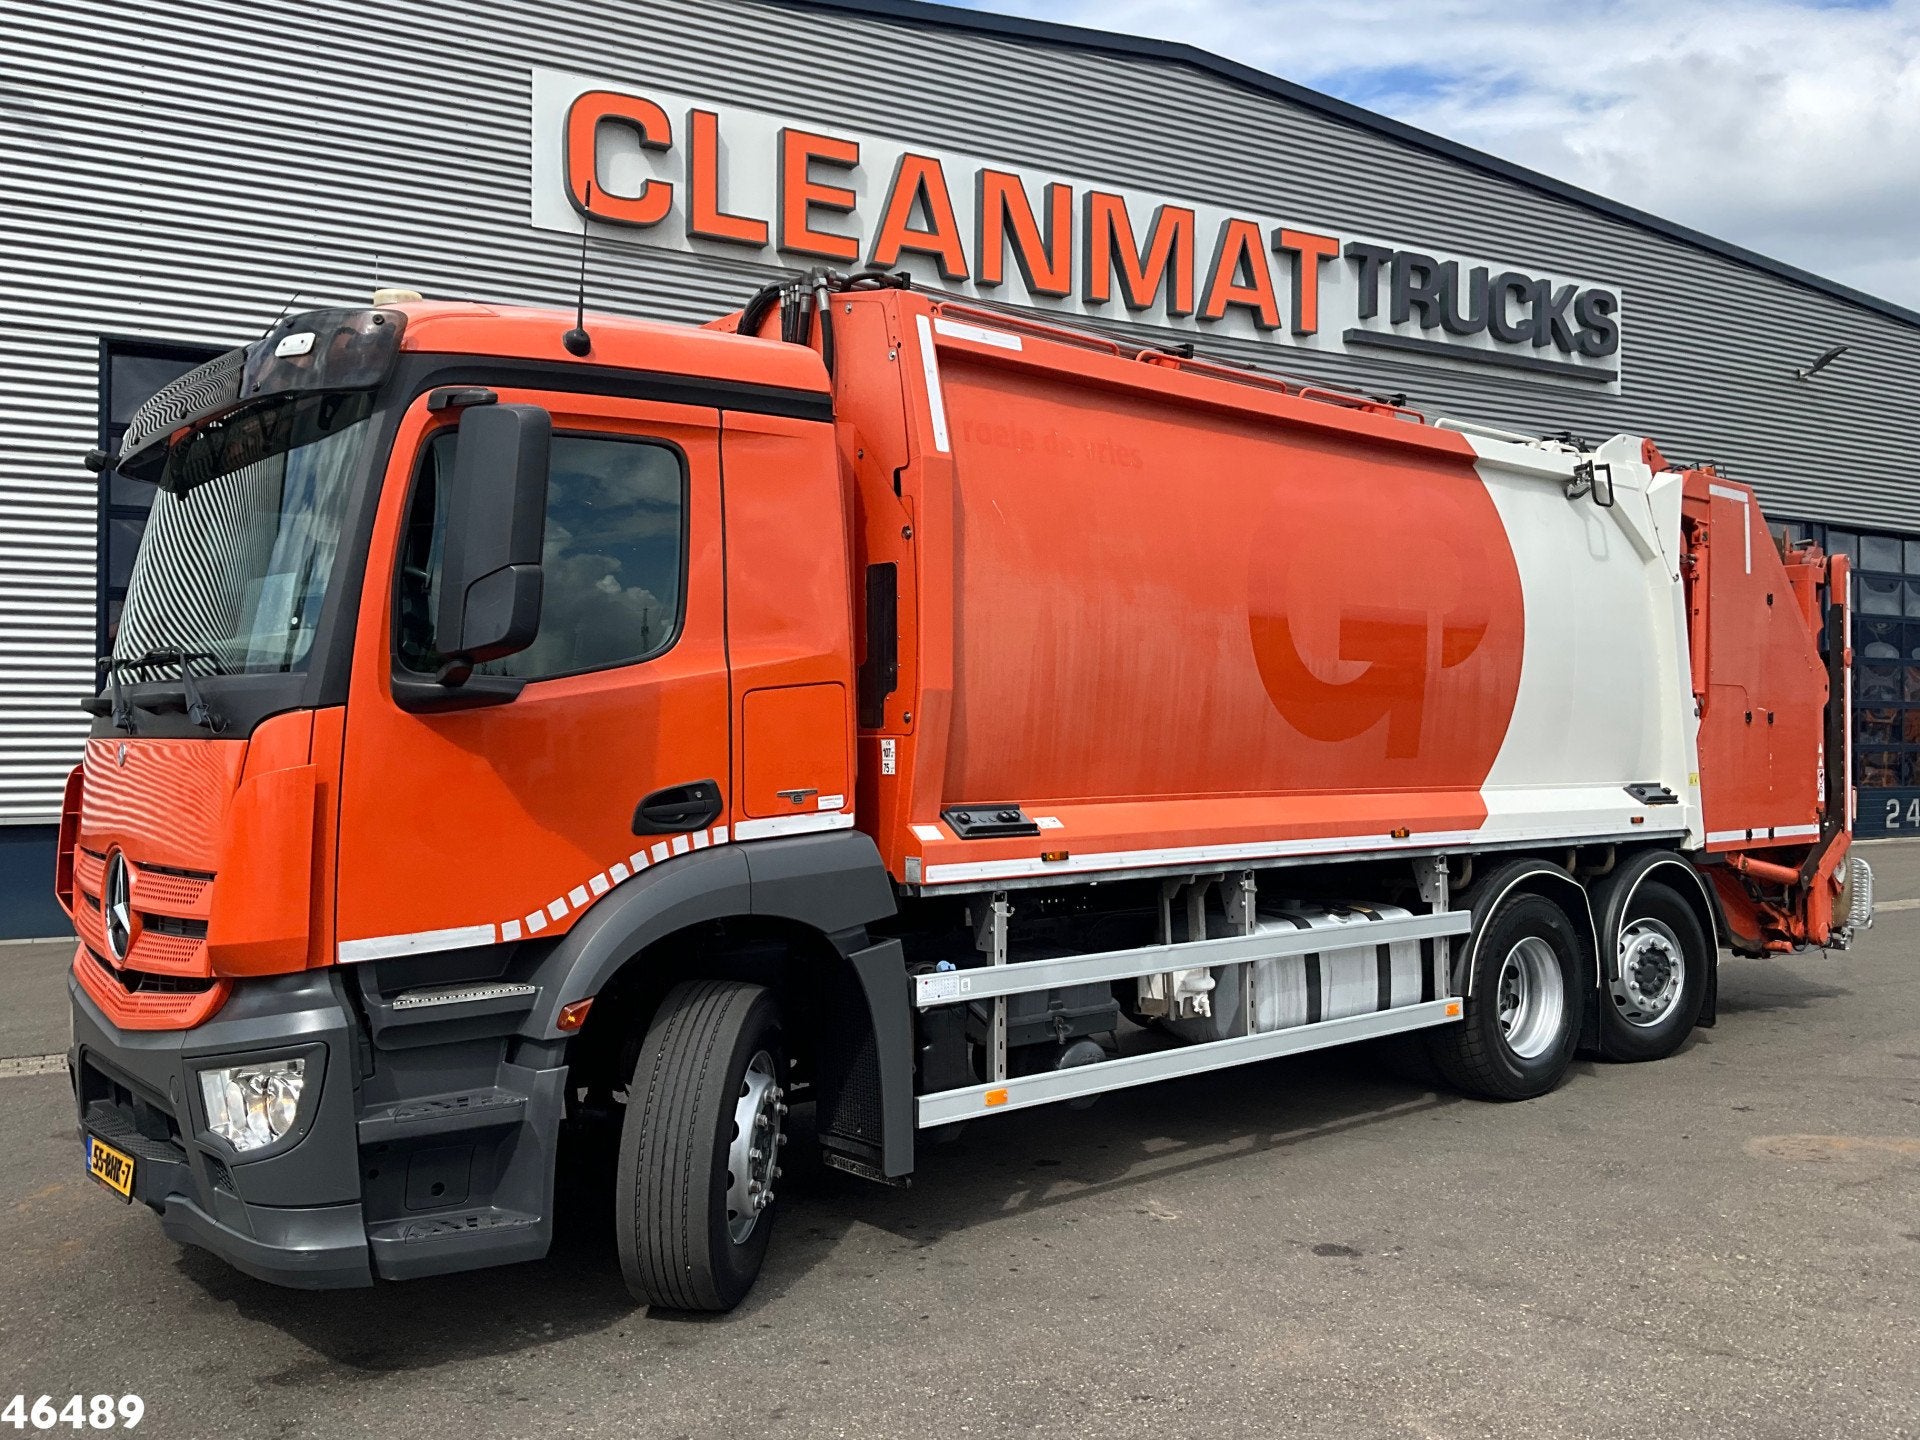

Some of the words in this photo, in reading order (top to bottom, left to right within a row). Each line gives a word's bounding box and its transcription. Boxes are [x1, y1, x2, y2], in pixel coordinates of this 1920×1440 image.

[562, 89, 1340, 337] CLEANMAT
[1343, 241, 1621, 358] TRUCKS
[1885, 798, 1920, 828] 24
